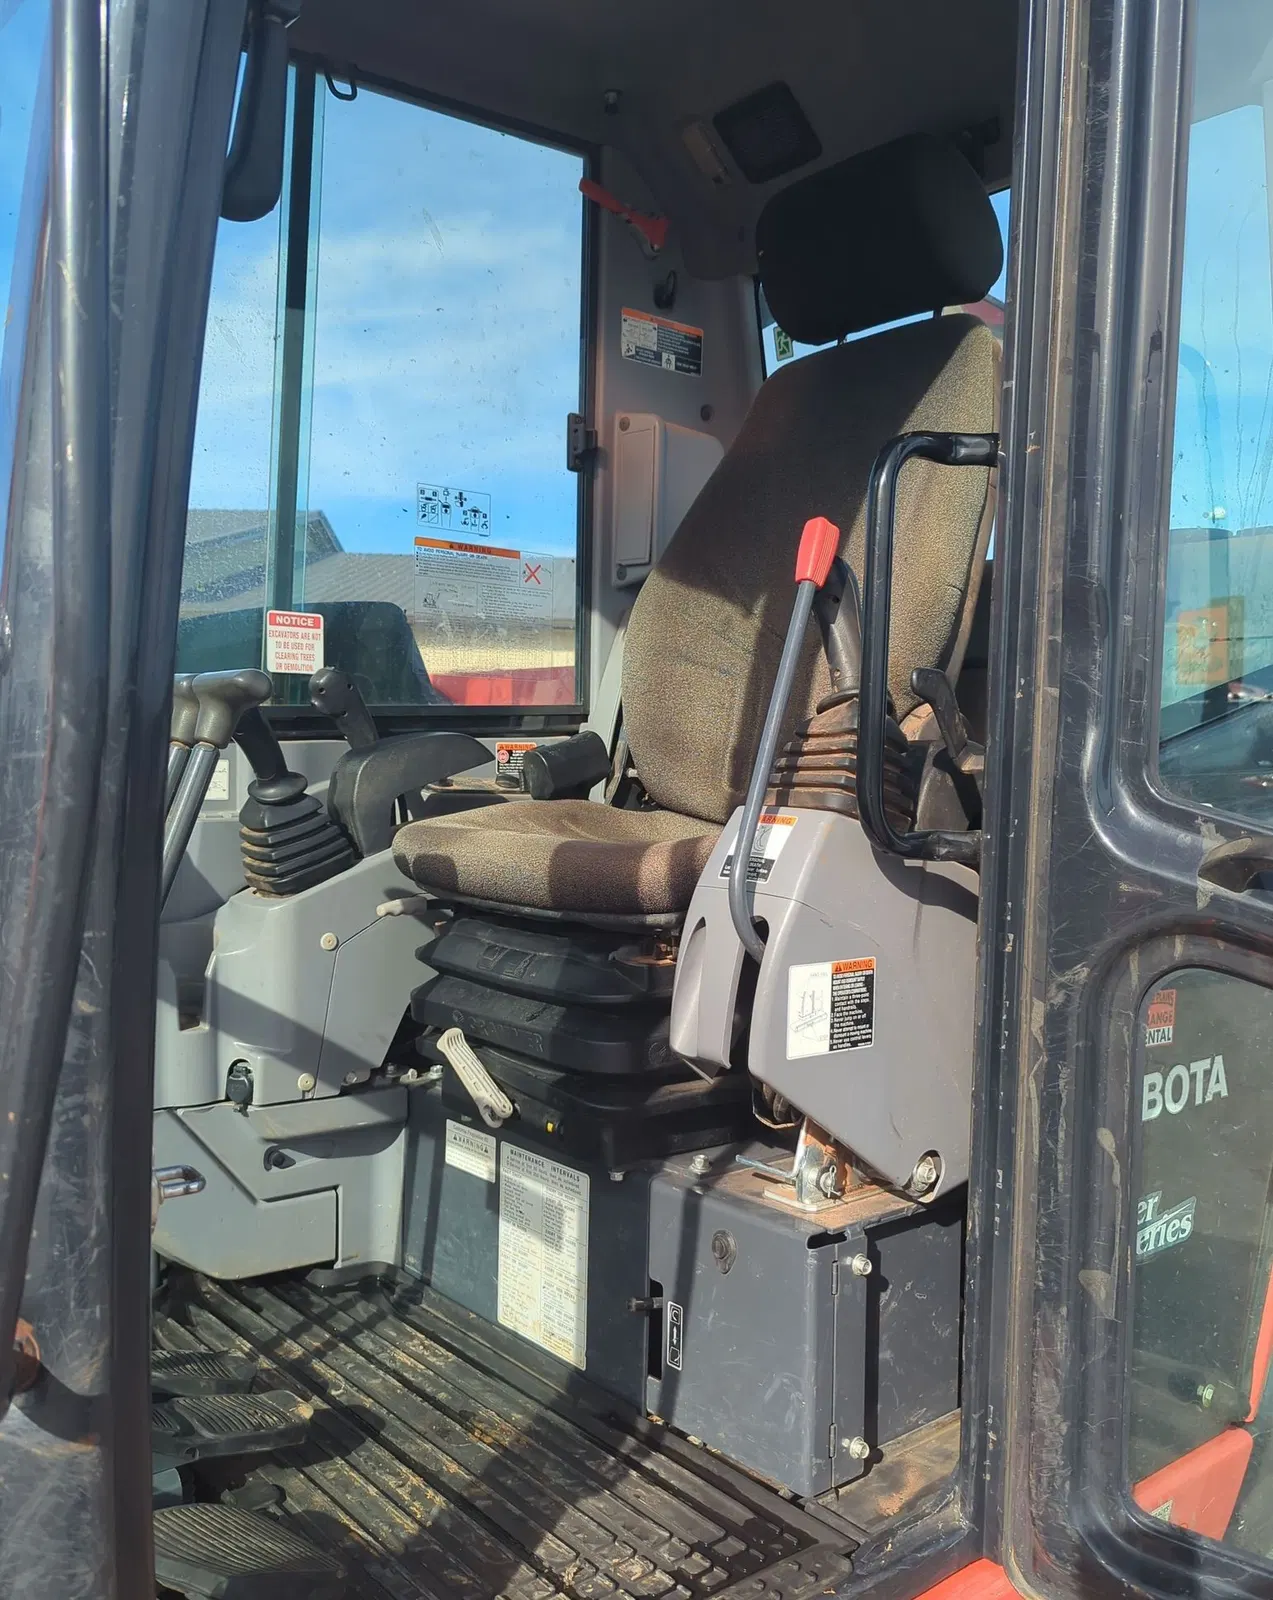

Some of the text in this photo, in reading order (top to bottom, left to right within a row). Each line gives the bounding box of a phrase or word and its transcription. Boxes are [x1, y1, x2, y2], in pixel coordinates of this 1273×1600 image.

[458, 543, 492, 554] WARNING
[276, 616, 315, 627] NOTICE
[269, 630, 321, 641] EXCAVATORS ARE NOT
[275, 641, 315, 651] TO BE USED FOR
[275, 651, 316, 662] CLEARING TREES
[276, 662, 283, 671] OR
[843, 959, 873, 971] WARNING
[1142, 1054, 1229, 1121] BOTA
[458, 1135, 485, 1151] WARNING
[510, 1149, 545, 1168] MAINTENANCE
[550, 1166, 580, 1182] INTERVALS
